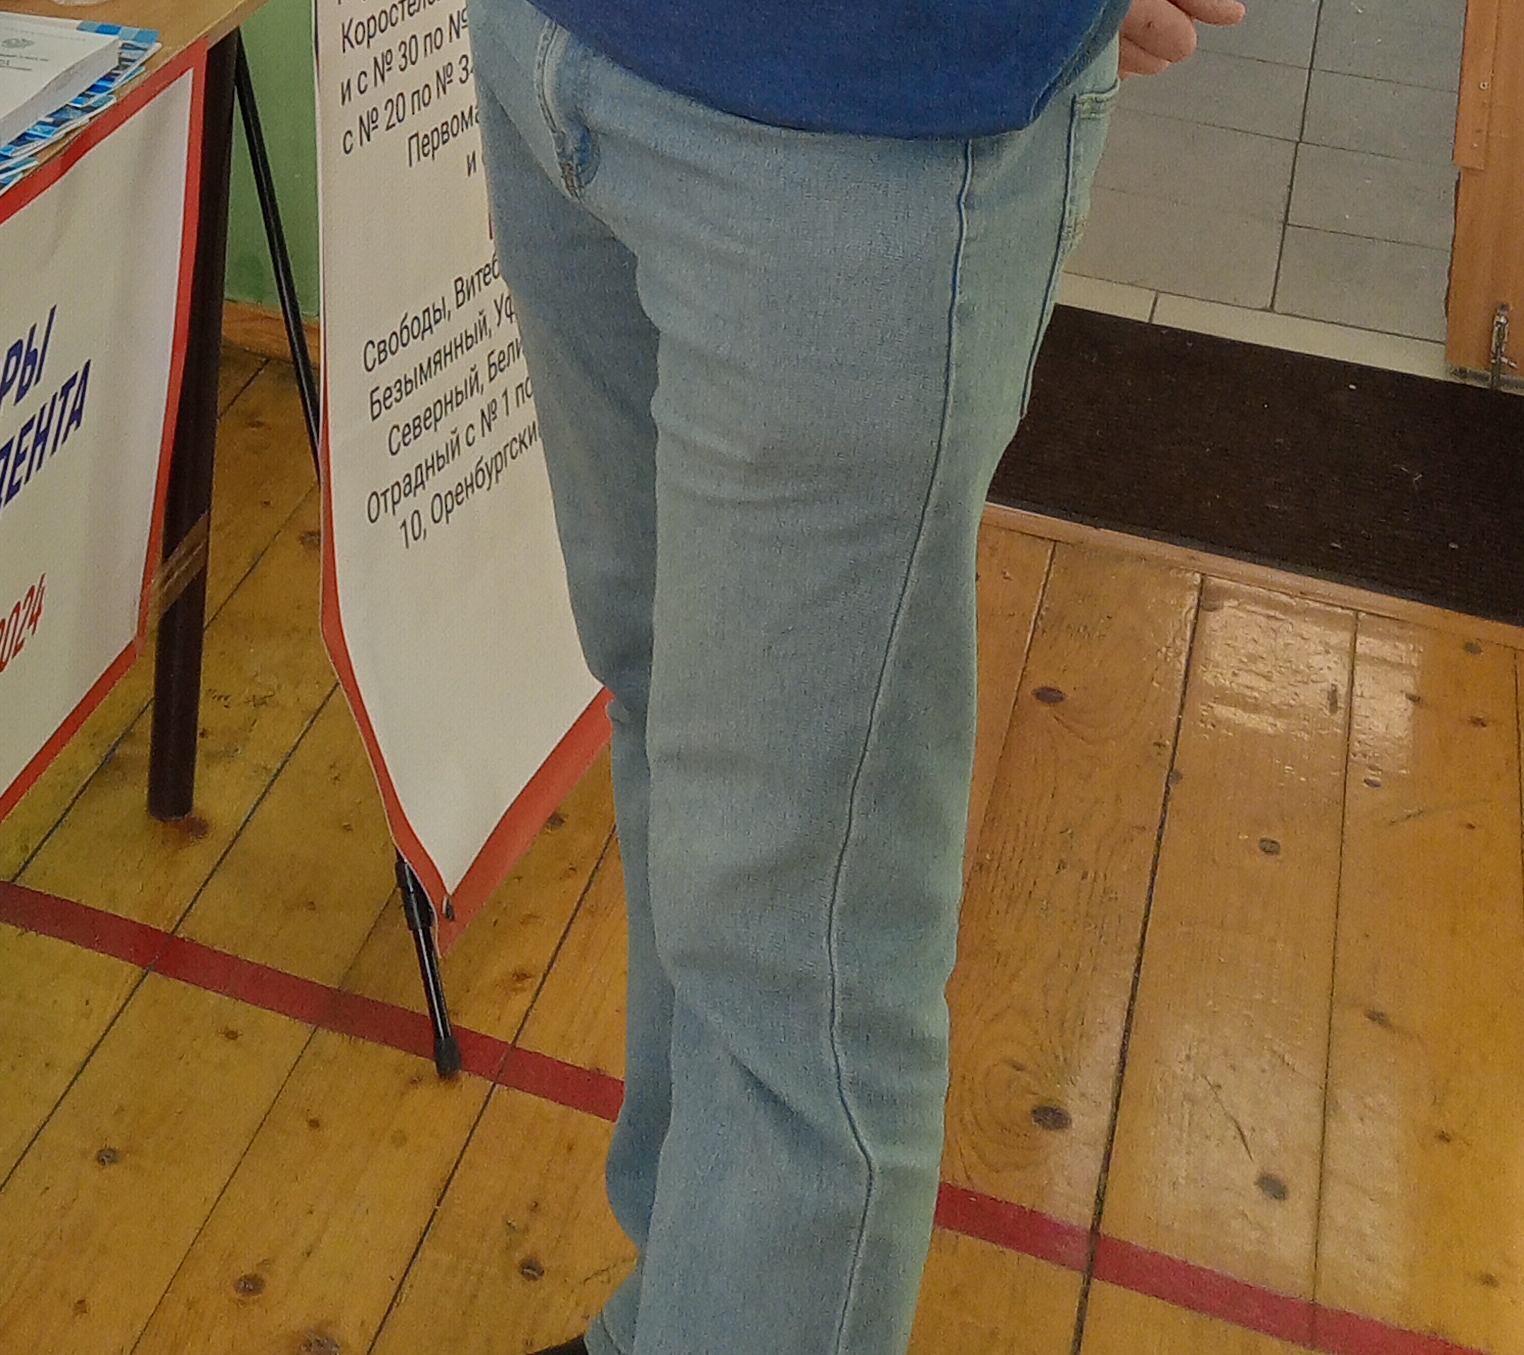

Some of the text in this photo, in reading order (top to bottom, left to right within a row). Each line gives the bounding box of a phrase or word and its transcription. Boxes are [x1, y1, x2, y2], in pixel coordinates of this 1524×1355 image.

[341, 80, 352, 106] и
[357, 70, 368, 95] с
[374, 49, 393, 88] №
[398, 33, 419, 73] 30
[423, 27, 444, 59] по
[342, 54, 473, 155] с № 20 по № 3
[466, 150, 477, 177] и
[363, 295, 452, 373] Свободы,
[369, 310, 492, 422] Безымянный,
[367, 376, 533, 524] Отрадный с № 1 по
[388, 364, 485, 457] Северный,
[399, 420, 540, 550] 10, Оренбургски
